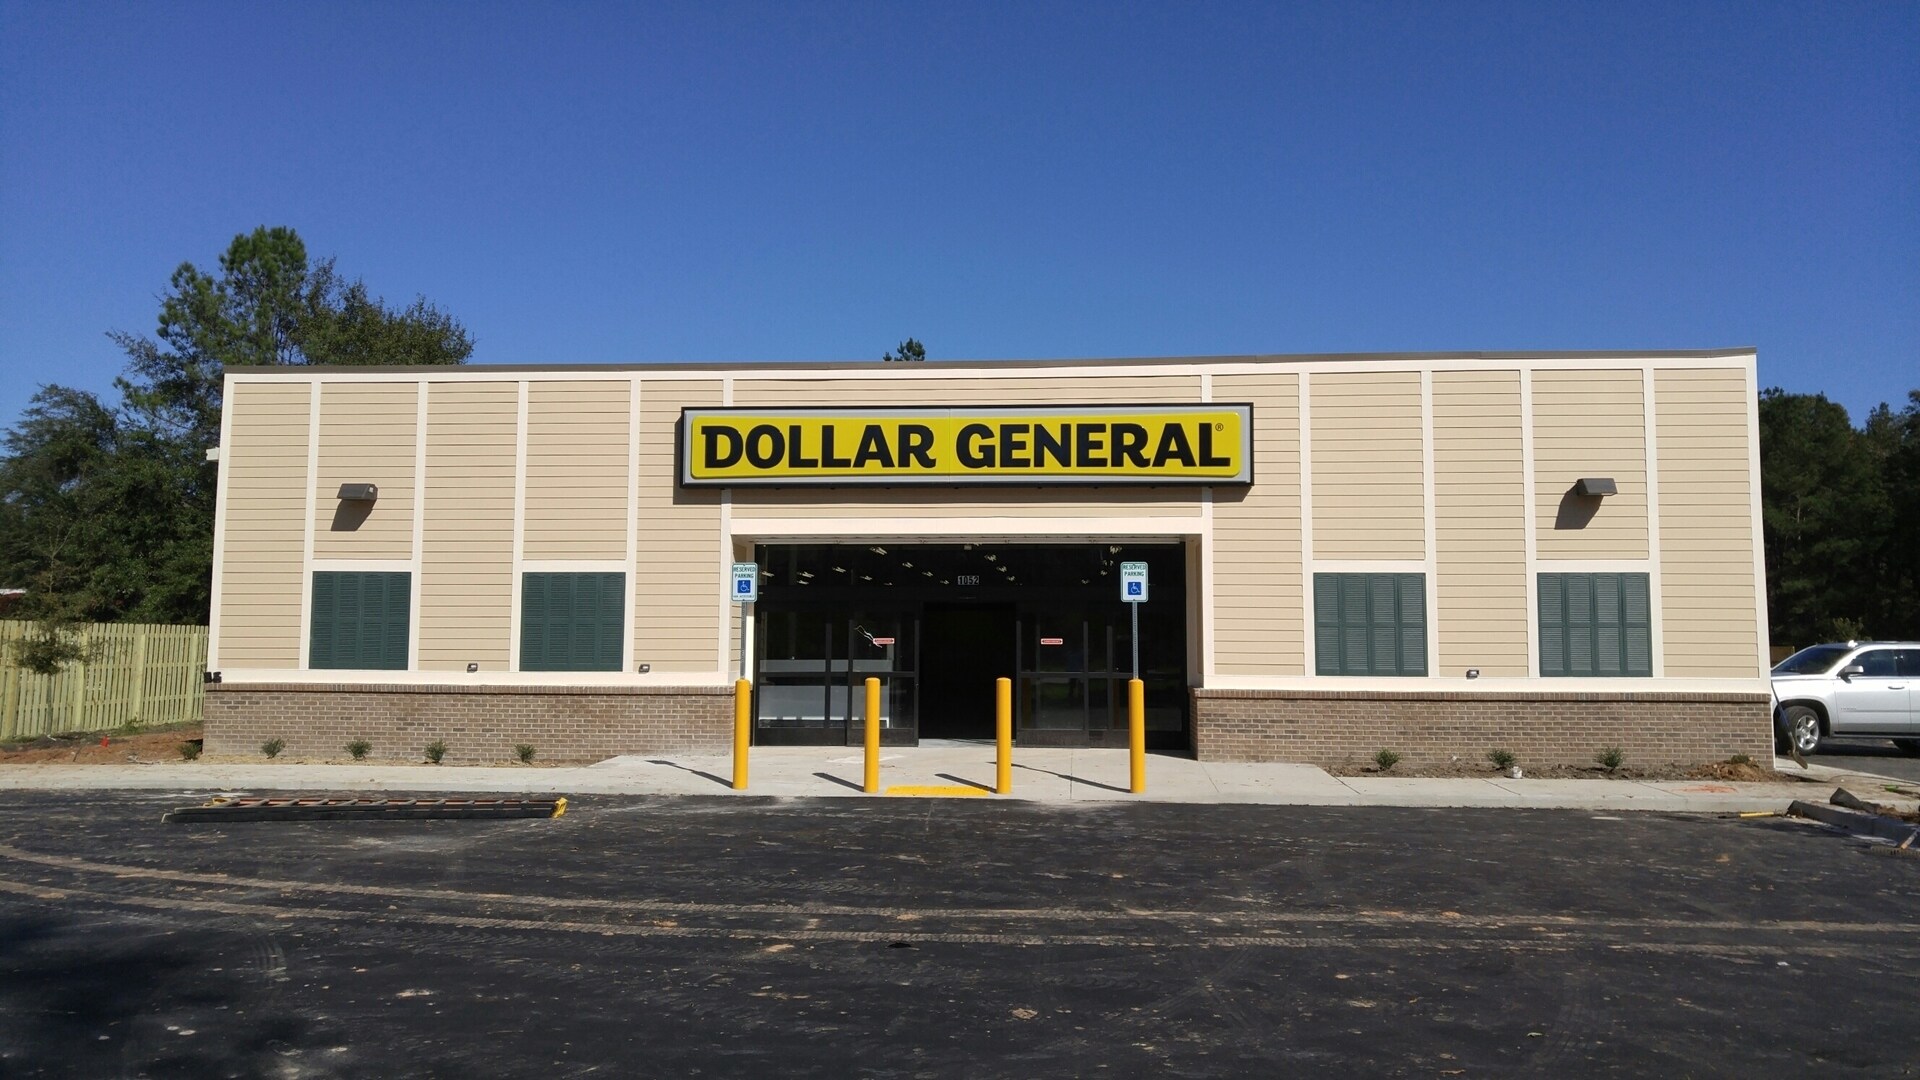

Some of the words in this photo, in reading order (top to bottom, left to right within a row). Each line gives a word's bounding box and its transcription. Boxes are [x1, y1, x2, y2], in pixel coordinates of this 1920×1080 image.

[701, 424, 936, 469] DOLLAR
[956, 423, 1231, 468] GENERAL
[958, 576, 979, 585] 1052
